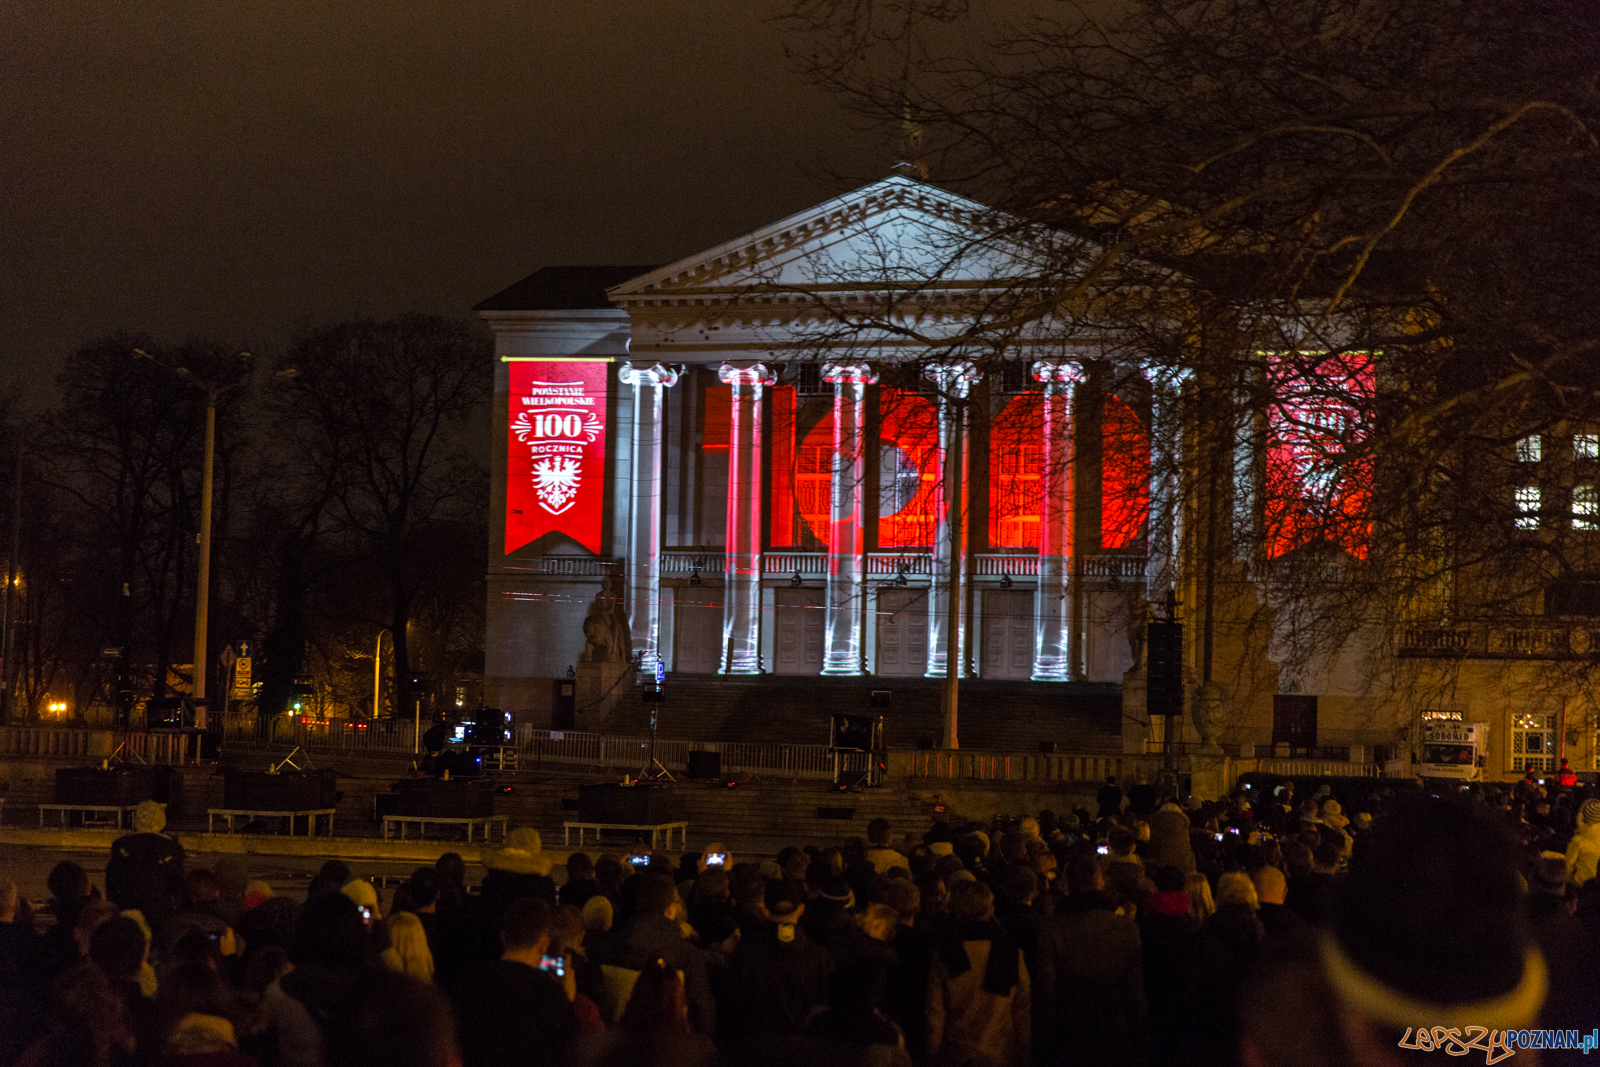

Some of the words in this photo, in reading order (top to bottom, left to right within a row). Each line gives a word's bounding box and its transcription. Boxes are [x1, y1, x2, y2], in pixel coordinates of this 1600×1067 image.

[532, 387, 585, 396] POWSTANIE
[521, 397, 596, 406] WIELKOPOLSKIE
[532, 413, 582, 438] 100
[531, 445, 583, 454] ROCZNICA
